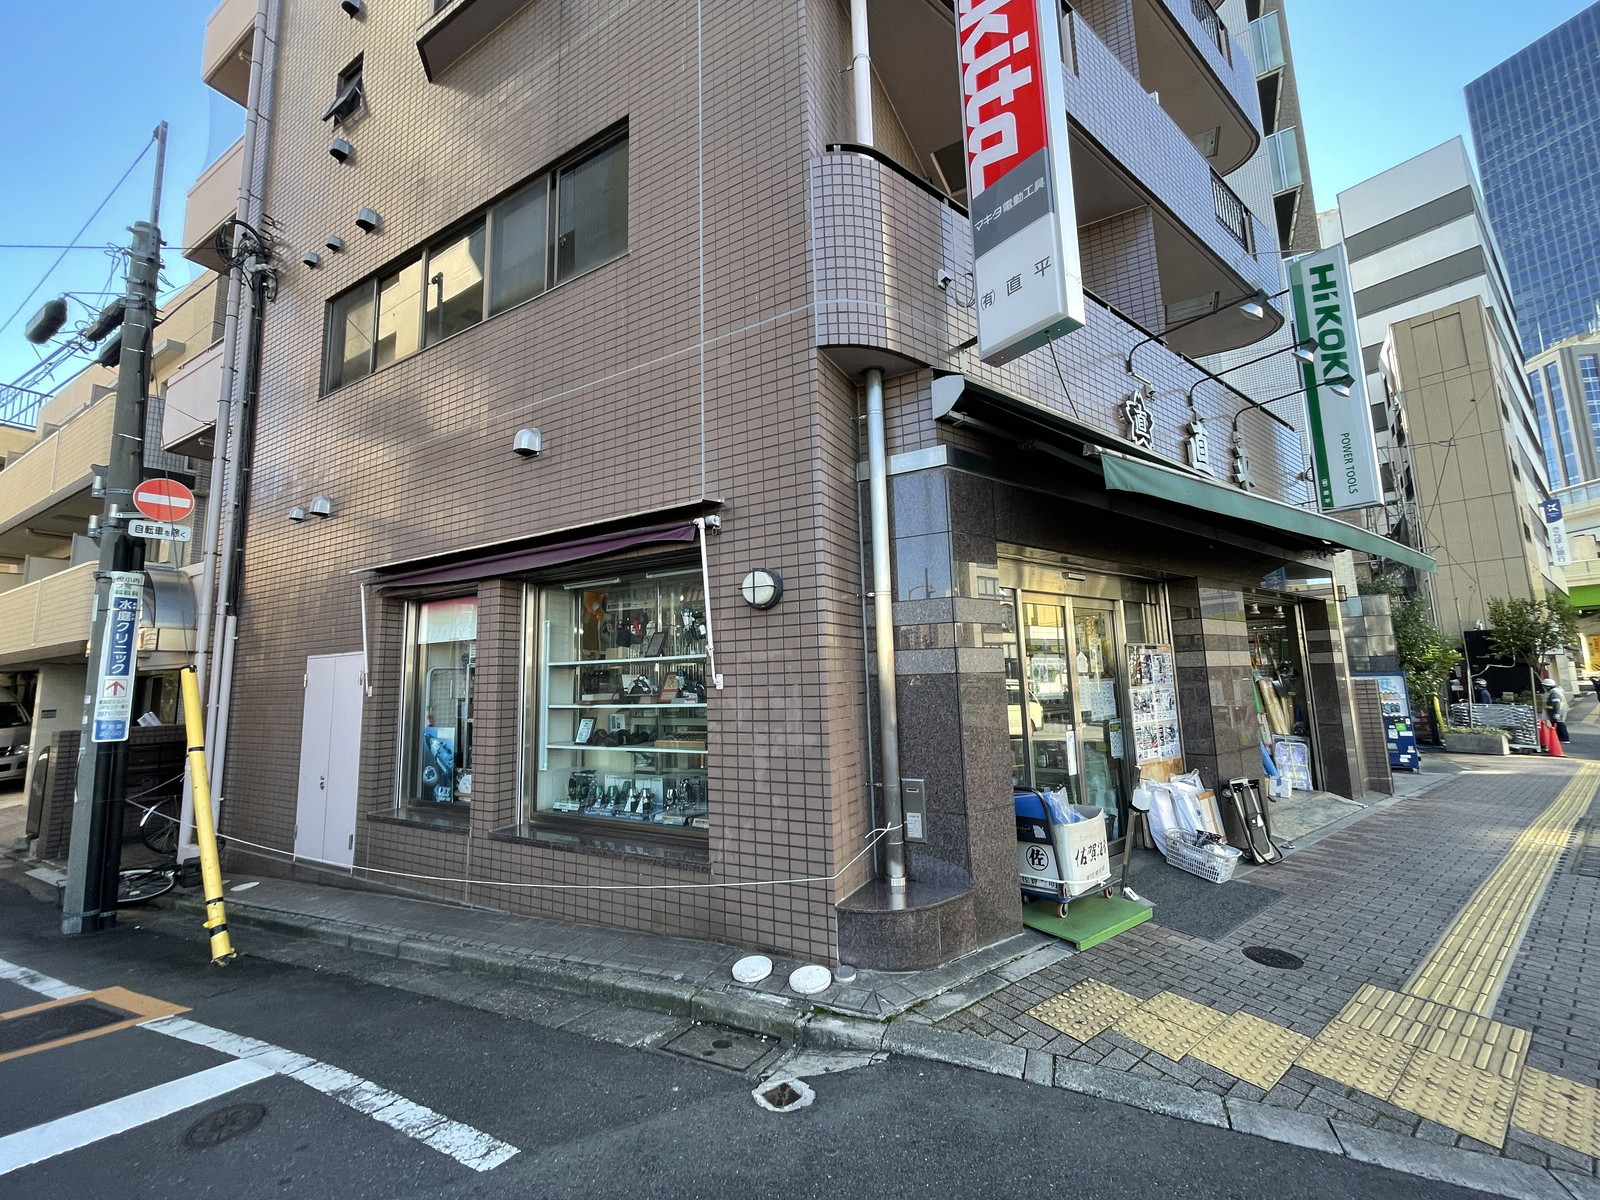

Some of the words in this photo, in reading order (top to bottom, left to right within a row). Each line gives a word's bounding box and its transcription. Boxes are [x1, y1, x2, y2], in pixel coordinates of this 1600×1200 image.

[958, 0, 1033, 200] kita
[974, 176, 1046, 231] マキタ電動工具
[1340, 432, 1353, 465] POWER
[1345, 466, 1359, 495] TOOLS
[135, 524, 186, 538] 自転車を除く
[111, 600, 132, 674] 水庭クリニック
[1029, 847, 1046, 867] 佐
